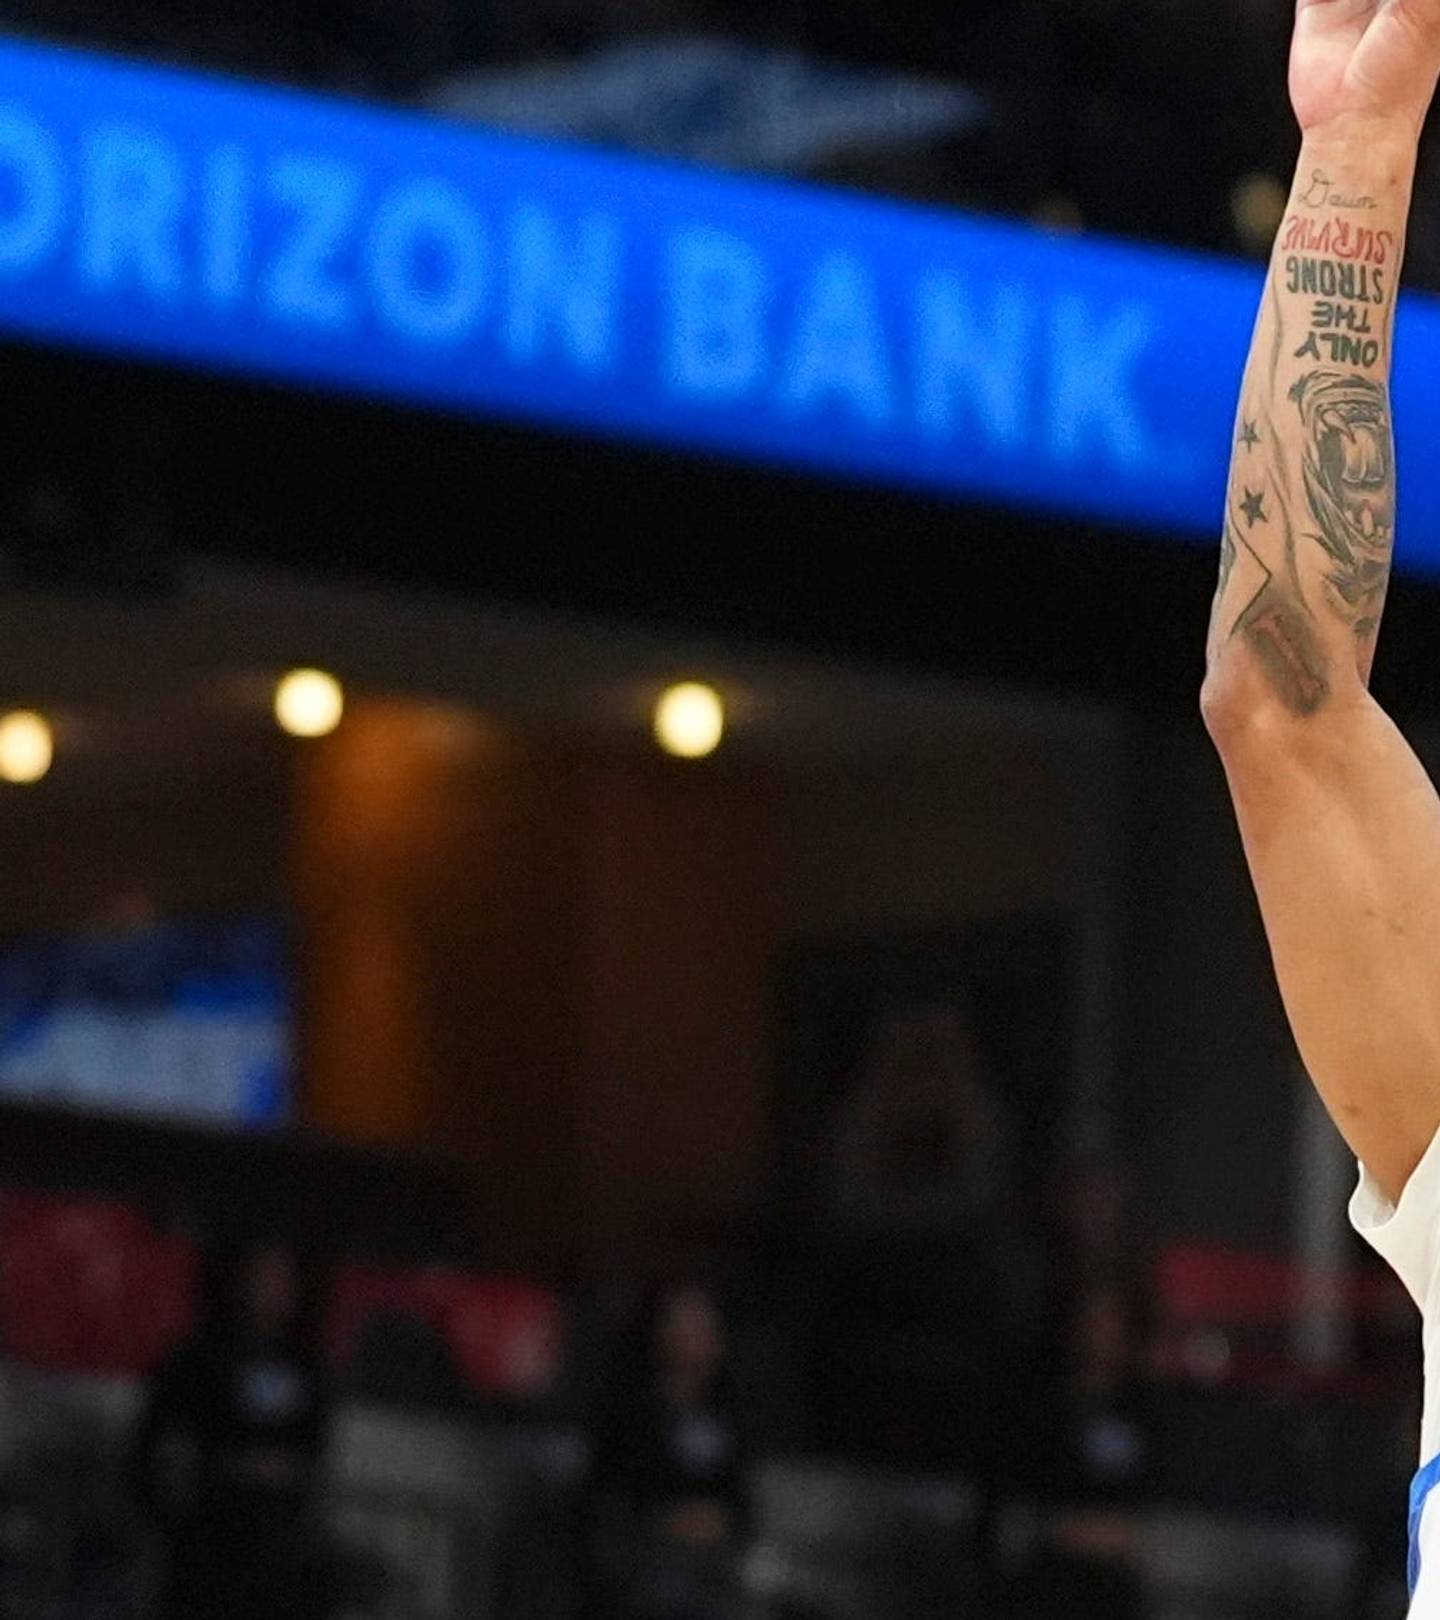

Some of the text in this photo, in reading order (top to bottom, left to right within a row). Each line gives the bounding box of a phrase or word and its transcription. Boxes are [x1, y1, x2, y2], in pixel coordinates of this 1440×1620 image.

[1281, 215, 1393, 265] SURVIVE
[1285, 256, 1383, 304] STRONG
[1311, 300, 1371, 333] THE
[662, 224, 1155, 472] BANK
[1293, 330, 1379, 368] ONLY
